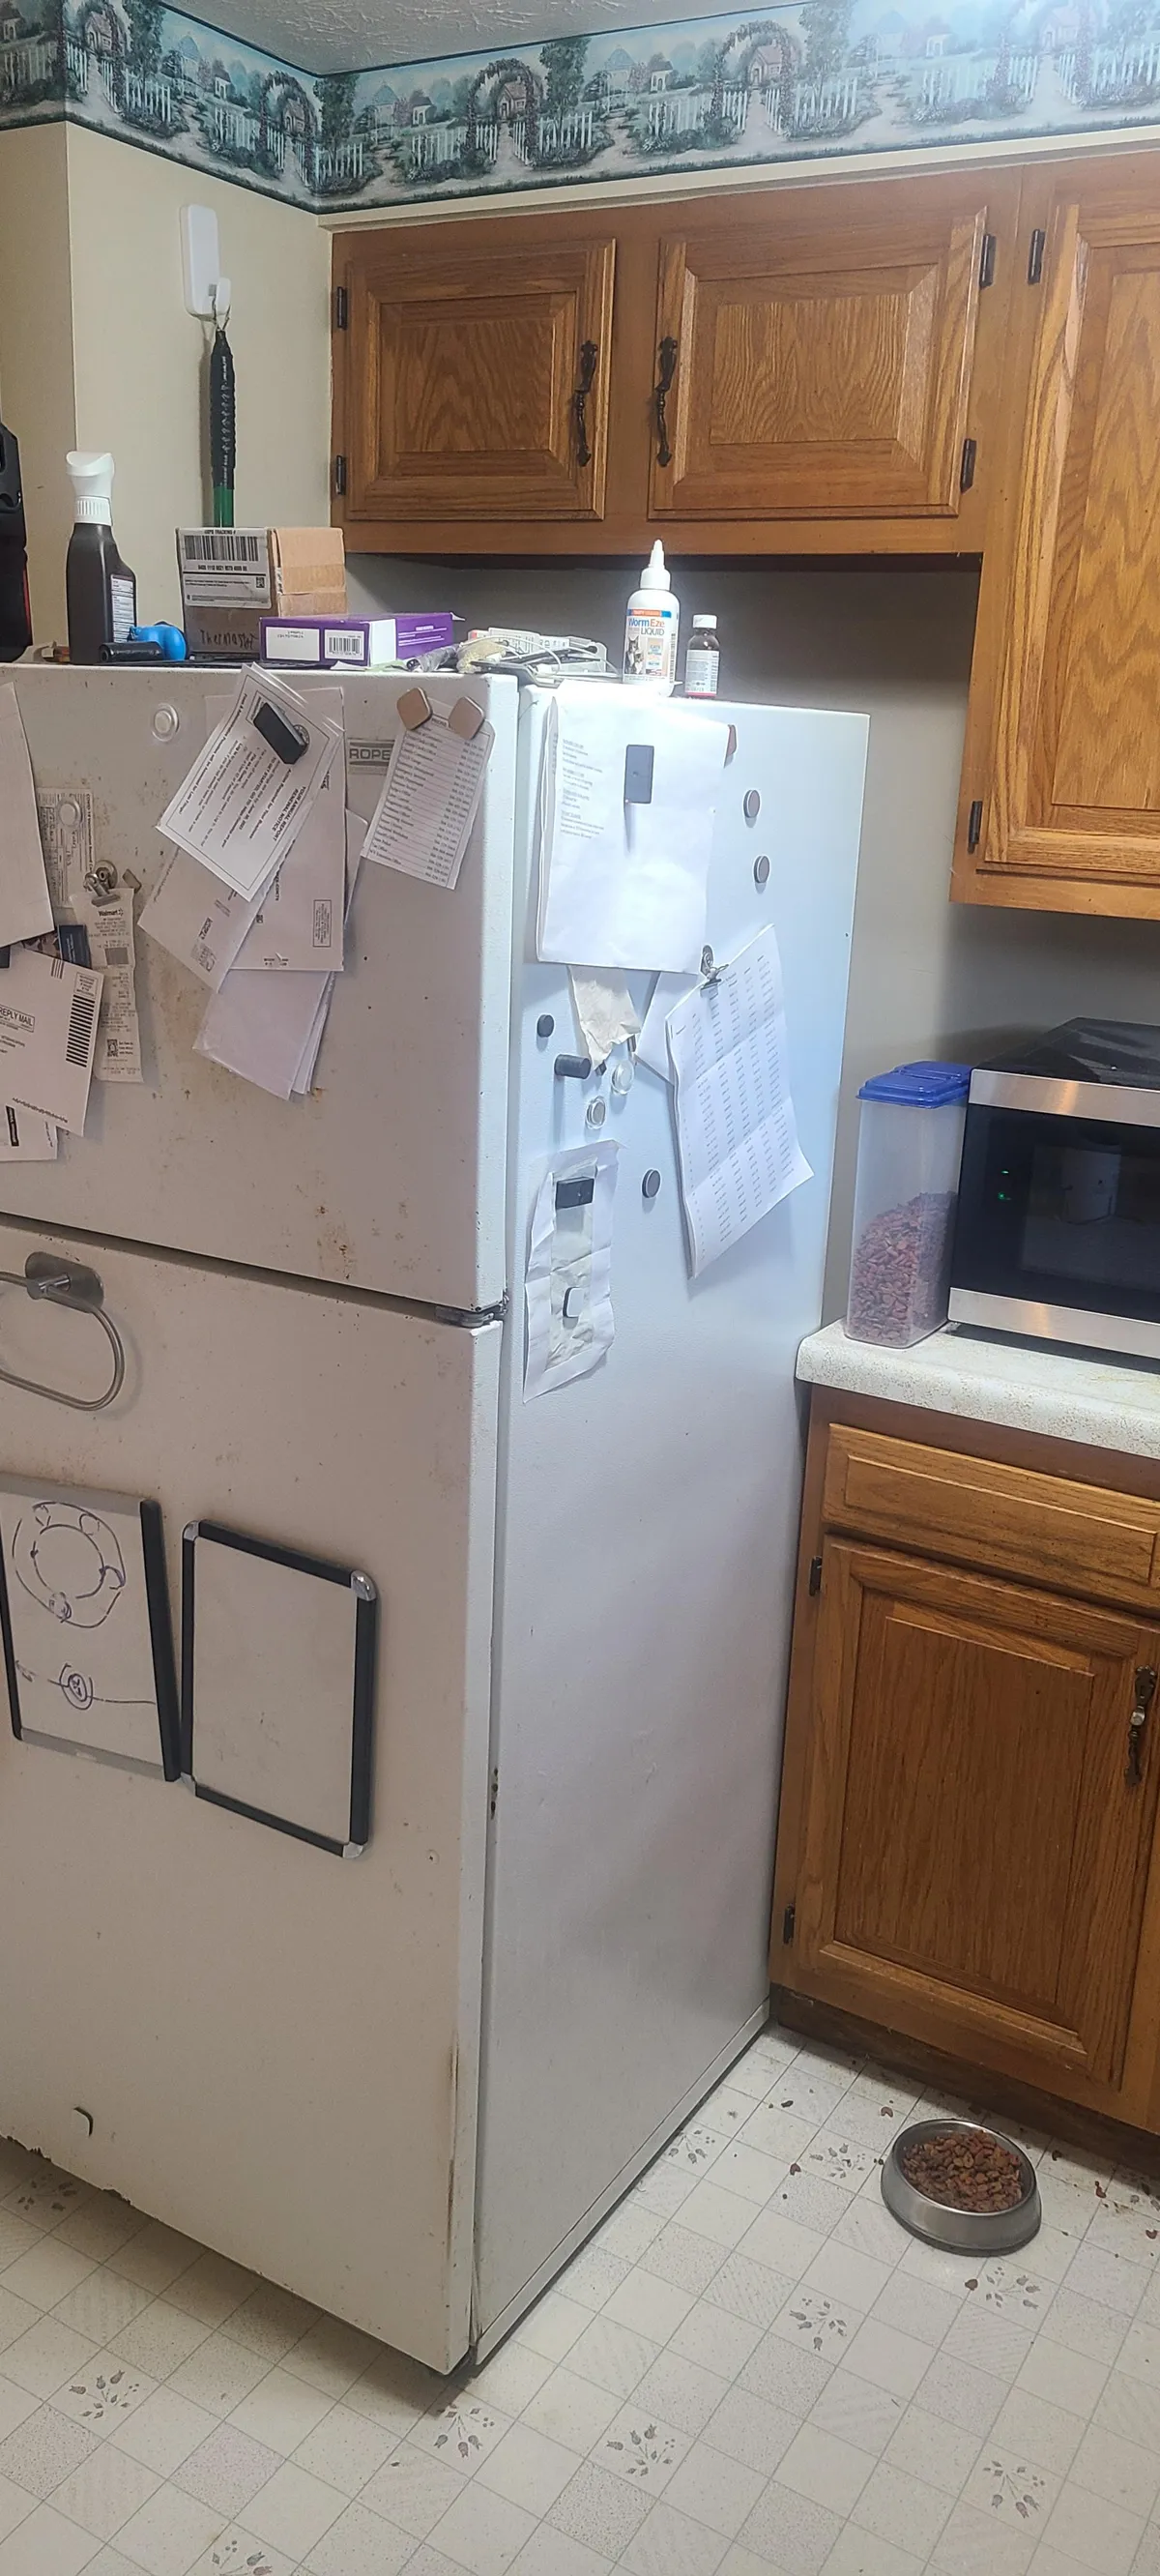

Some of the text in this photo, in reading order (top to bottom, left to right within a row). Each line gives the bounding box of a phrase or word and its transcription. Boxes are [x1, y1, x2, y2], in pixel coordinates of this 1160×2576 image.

[271, 787, 299, 832] RENEWAL NOTICE
[272, 785, 305, 841] YOUR ANNUAL REPORT
[98, 908, 117, 917] Walmart
